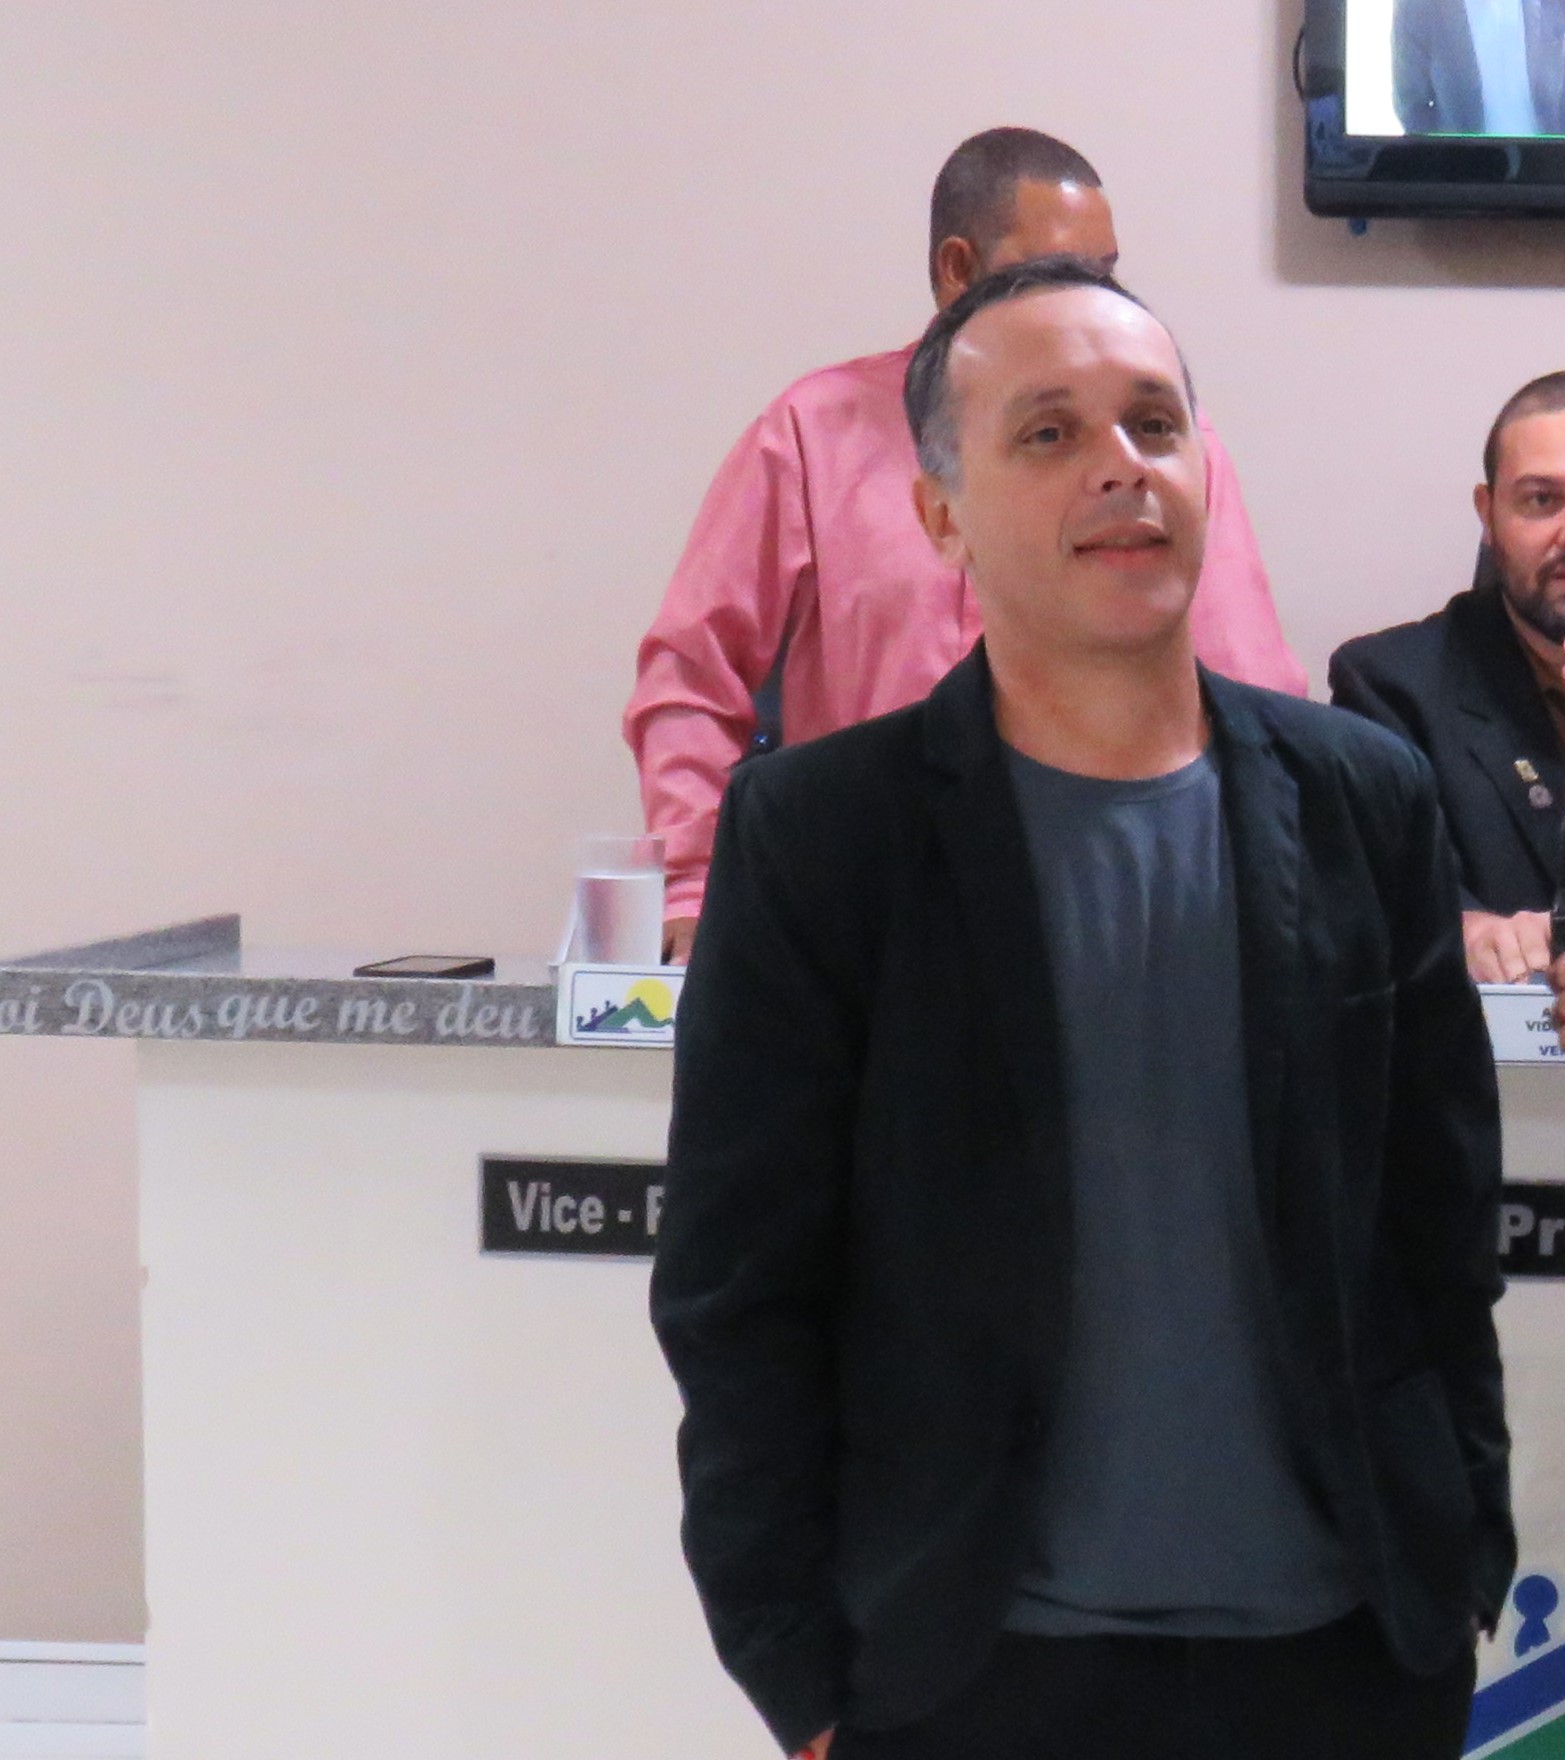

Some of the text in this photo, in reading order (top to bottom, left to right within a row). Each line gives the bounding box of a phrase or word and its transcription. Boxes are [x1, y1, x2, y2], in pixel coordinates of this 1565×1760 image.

[61, 979, 204, 1038] Deus
[216, 994, 321, 1039] que
[336, 997, 421, 1036] me
[436, 981, 541, 1039] deu
[506, 1180, 606, 1235] Vice
